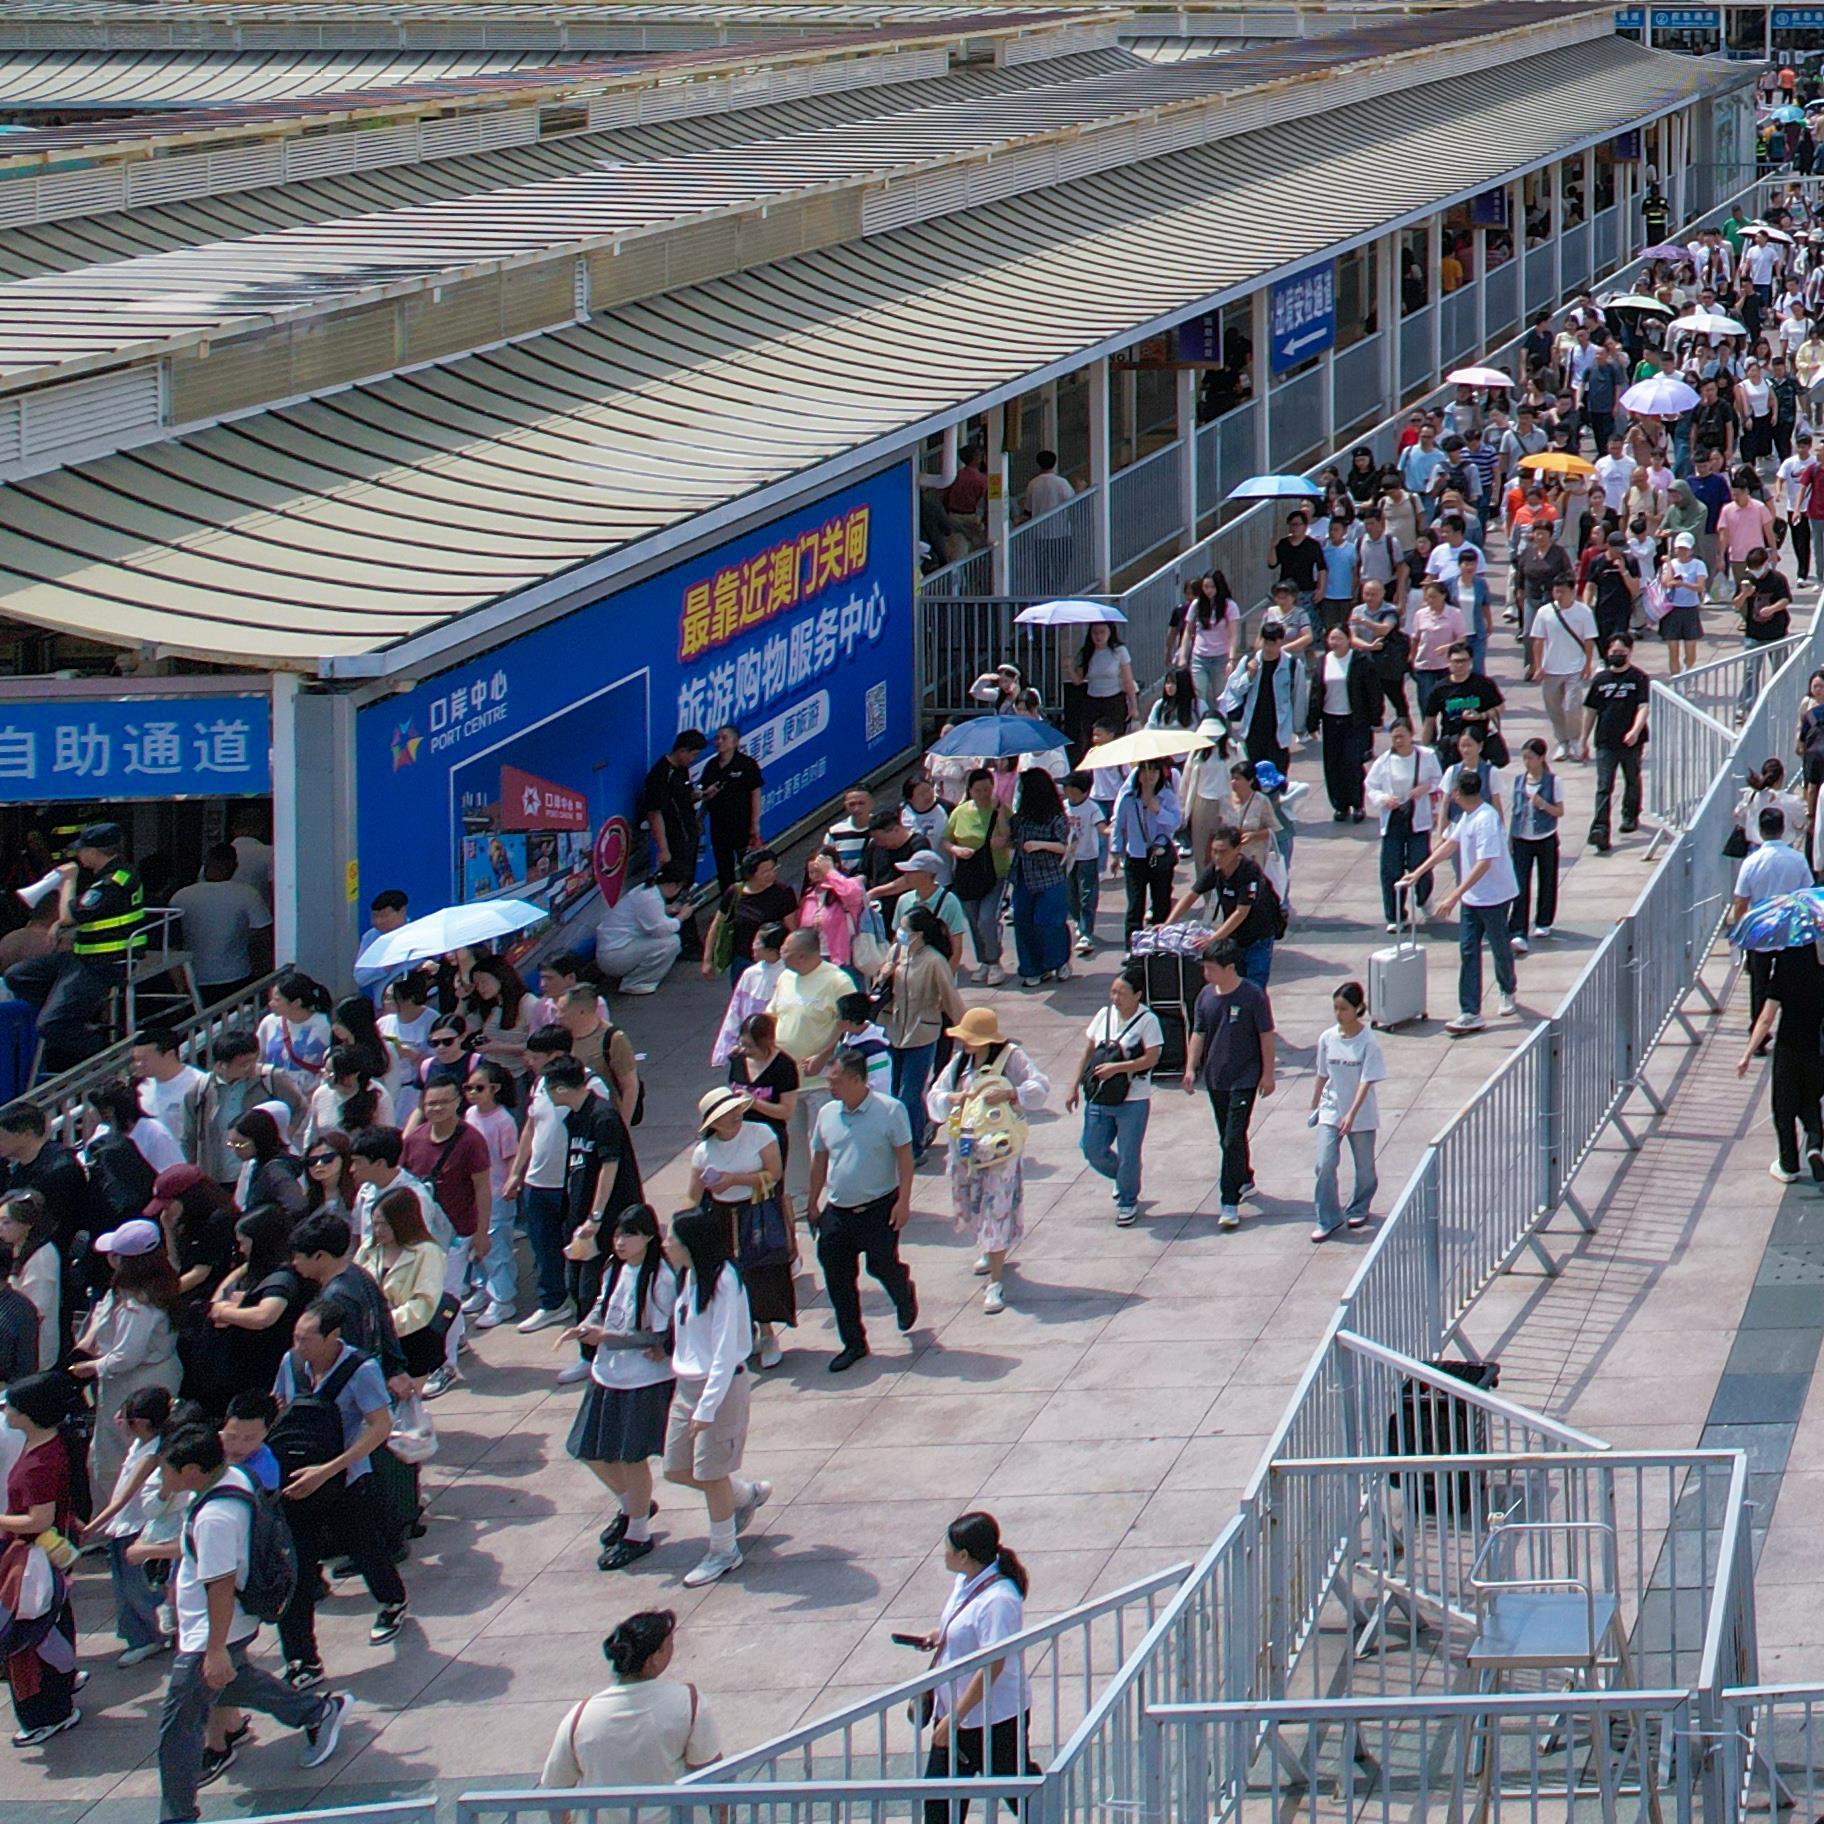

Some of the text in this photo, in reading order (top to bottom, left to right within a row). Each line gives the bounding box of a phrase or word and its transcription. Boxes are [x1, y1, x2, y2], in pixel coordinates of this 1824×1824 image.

[681, 507, 869, 658] 最靠近澳门关闸
[677, 581, 886, 735] 旅游购物服务中心
[429, 669, 508, 733] 口岸中心
[430, 702, 509, 755] PORT CENTRE
[0, 719, 251, 780] 自助通道
